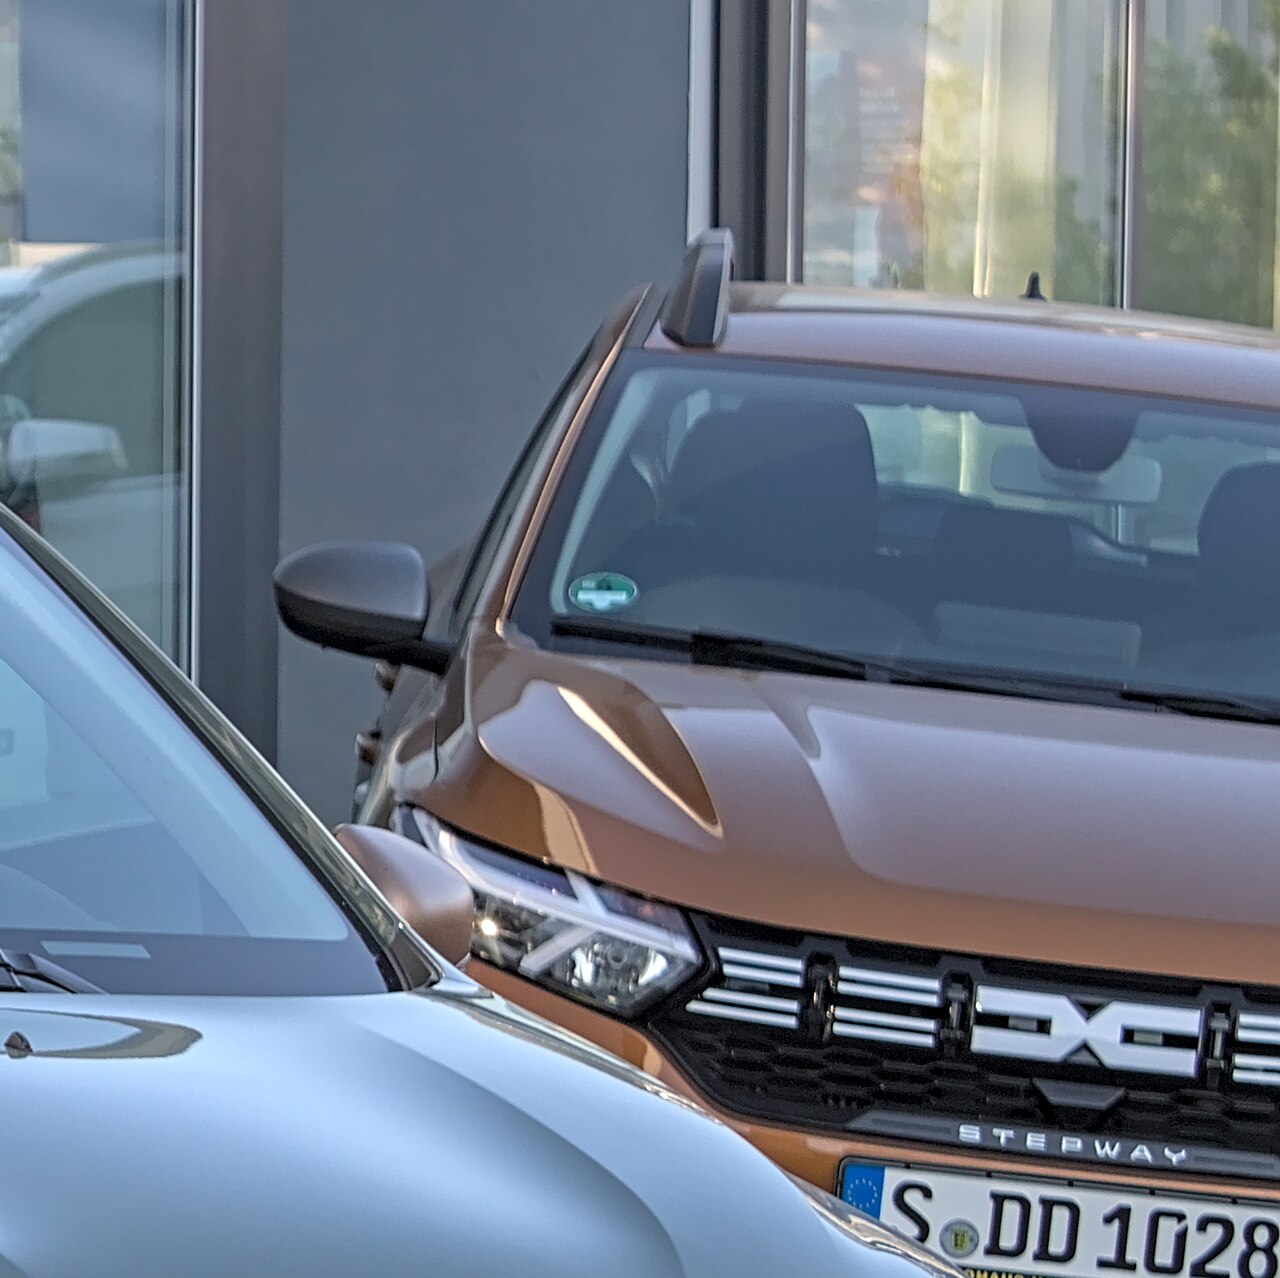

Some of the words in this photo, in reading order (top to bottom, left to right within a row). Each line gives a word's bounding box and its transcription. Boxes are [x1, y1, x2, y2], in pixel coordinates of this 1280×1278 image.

[958, 1123, 1187, 1166] STEPWAY
[892, 1179, 933, 1243] S
[983, 1189, 1080, 1263] DD
